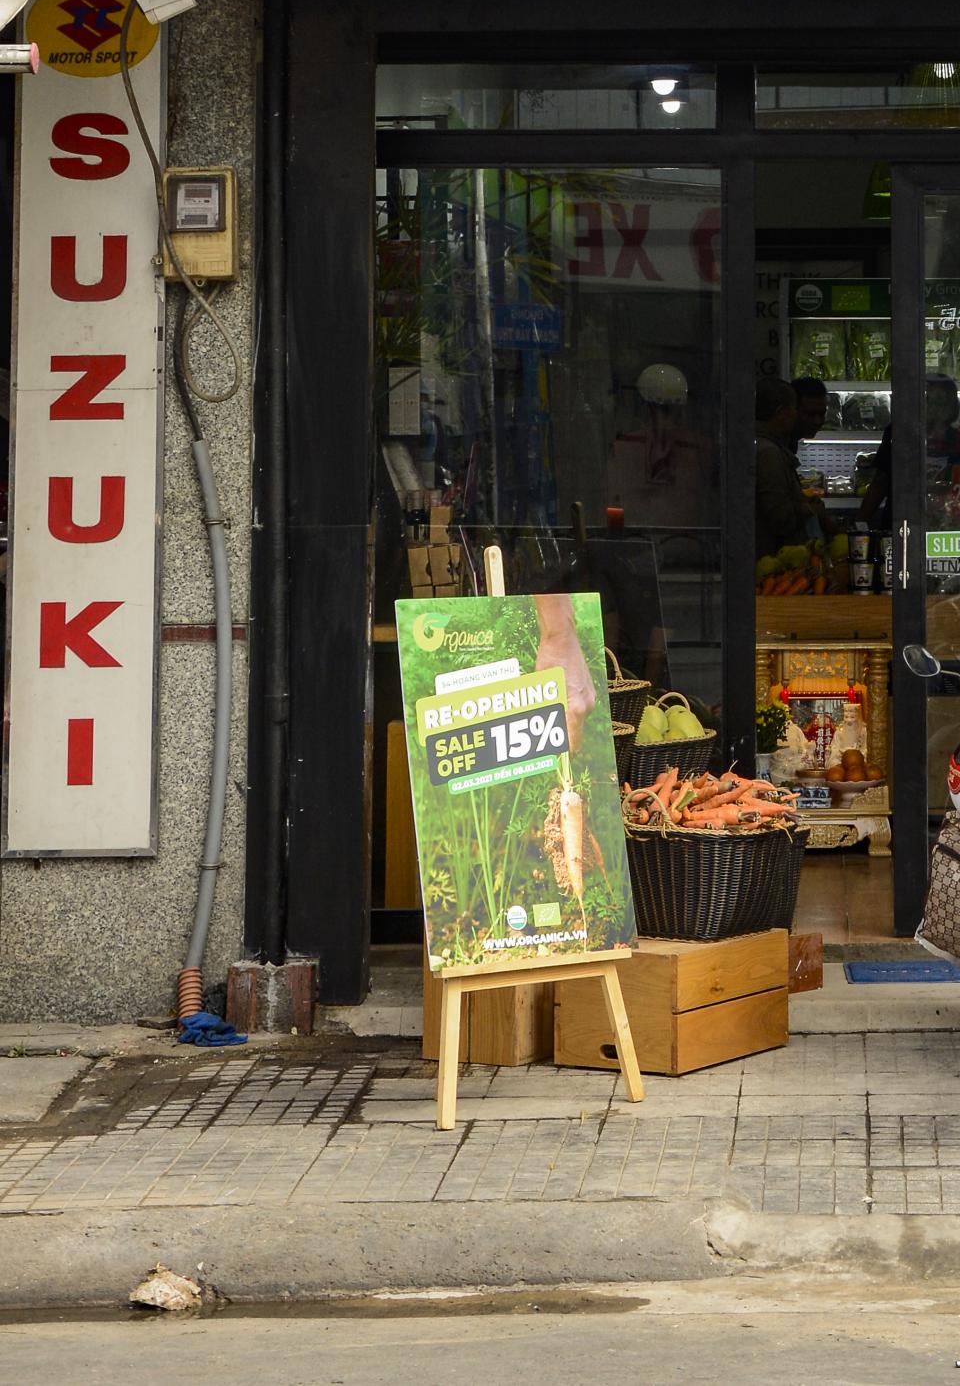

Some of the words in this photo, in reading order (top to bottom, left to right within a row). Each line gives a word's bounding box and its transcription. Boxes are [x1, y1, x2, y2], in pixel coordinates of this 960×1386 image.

[48, 52, 92, 64] MOTOR
[39, 112, 131, 786] SUZUKI
[413, 612, 494, 653] Organica
[424, 680, 558, 729] RE-OPENING
[435, 730, 486, 758] SALE
[491, 711, 565, 763] 15%
[437, 753, 476, 777] OFF
[483, 929, 588, 950] WWW.ORGANICA.VN
